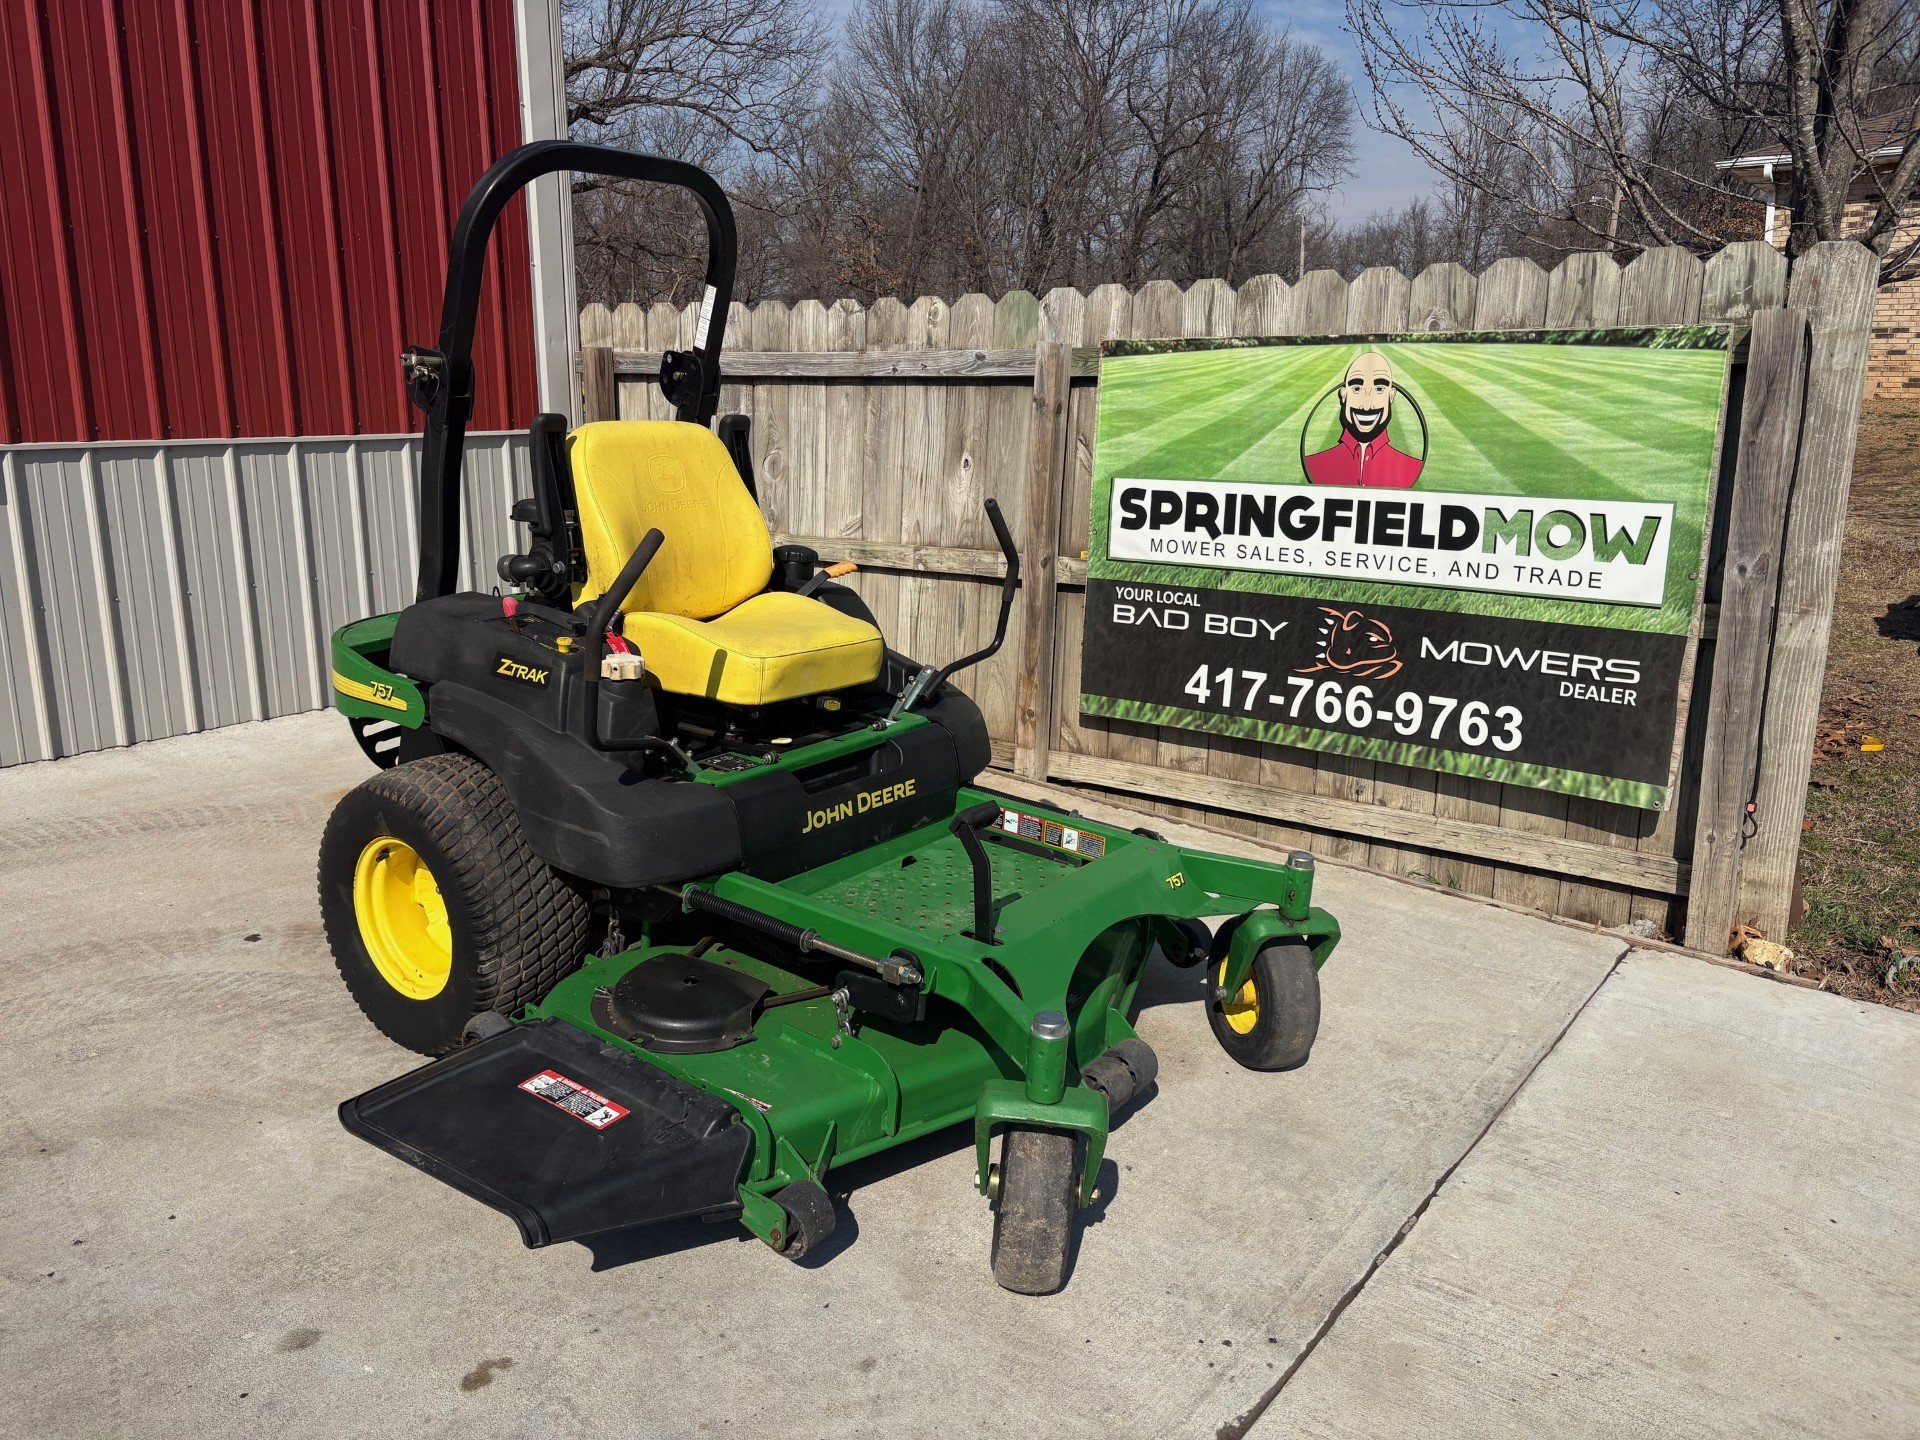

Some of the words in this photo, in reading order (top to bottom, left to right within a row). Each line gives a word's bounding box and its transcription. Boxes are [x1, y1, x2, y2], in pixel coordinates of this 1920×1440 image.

[1119, 487, 1662, 566] SPRINGFIELDMOW
[1150, 538, 1226, 558] MOWER
[1236, 544, 1313, 567] SALES,
[1324, 550, 1437, 578] SERVICE,
[1448, 560, 1500, 580] AND
[1513, 565, 1603, 589] TRADE
[1115, 586, 1153, 603] YOUR
[1156, 590, 1201, 607] LOCAL
[1112, 603, 1190, 631] BAD
[1203, 613, 1289, 641] BOY
[1420, 636, 1641, 684] MOWERS
[370, 681, 394, 701] 757
[496, 658, 550, 685] ZTRAK
[1184, 663, 1523, 752] 417-766-9763
[1559, 681, 1638, 707] DEALER
[802, 800, 853, 834] JOHN
[856, 778, 916, 814] DEERE
[1165, 871, 1185, 890] 757
